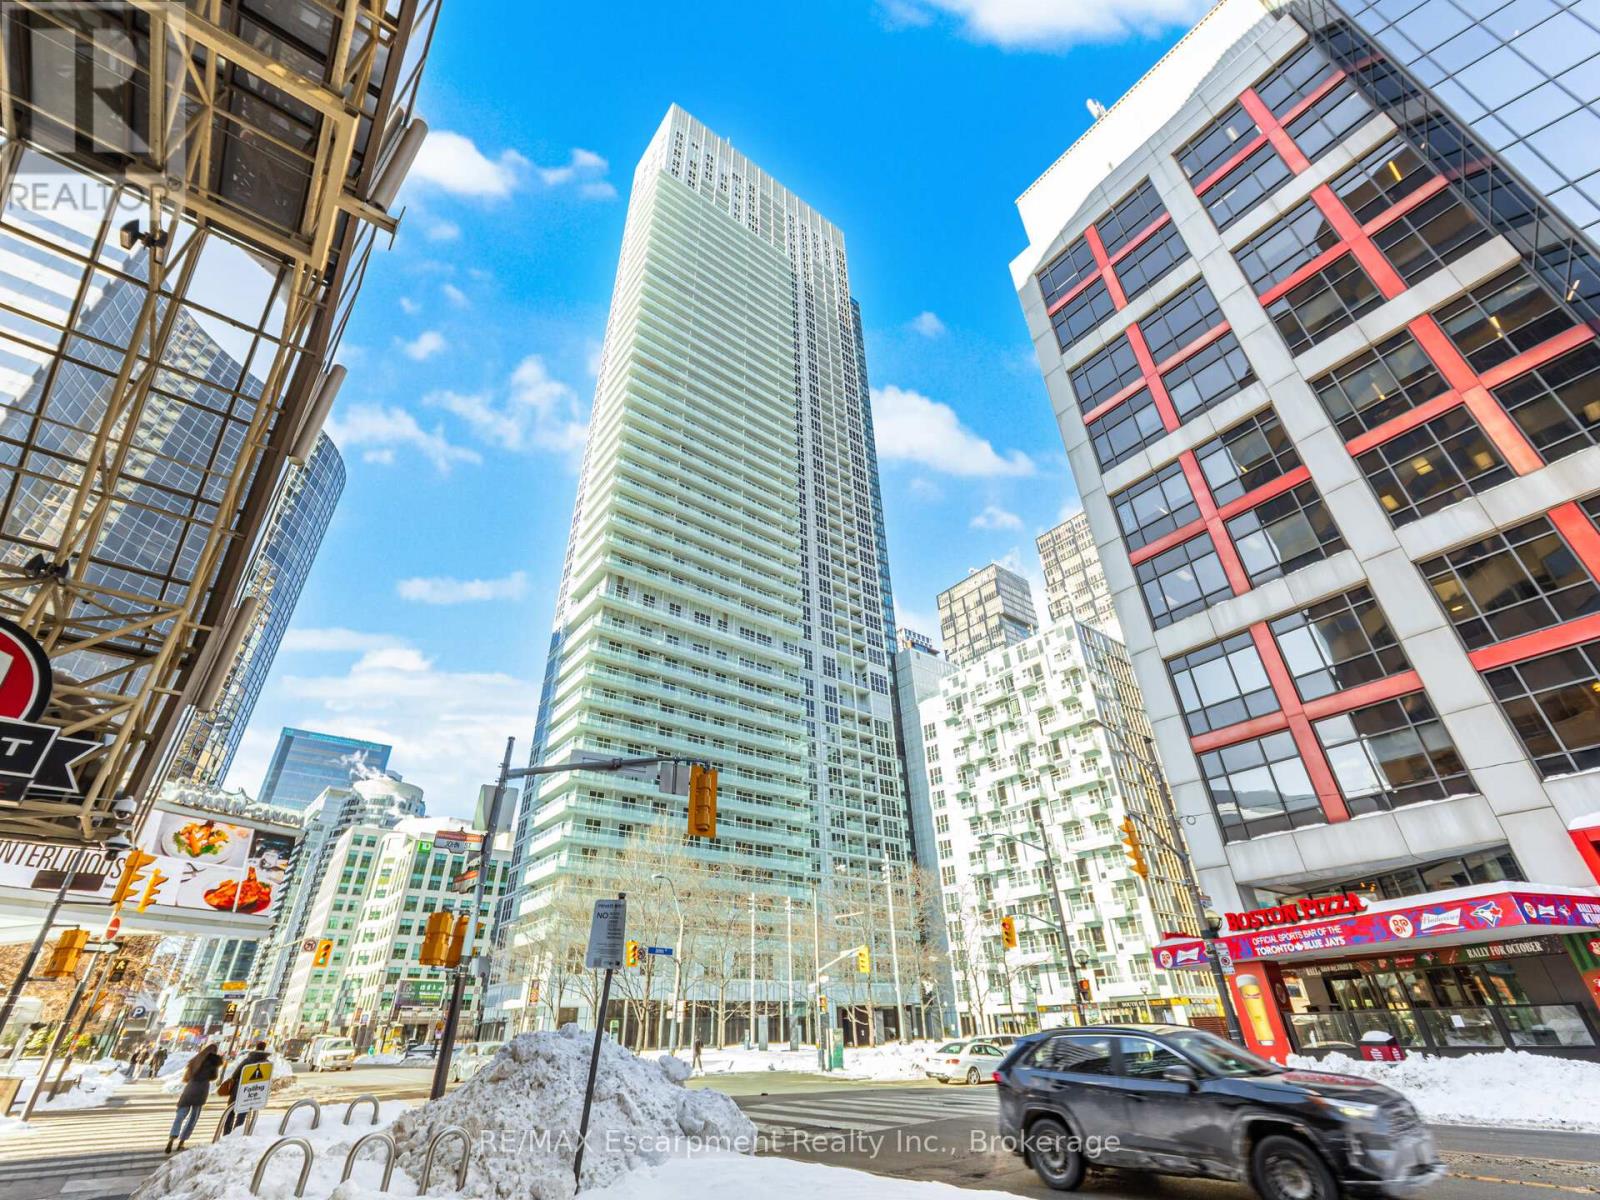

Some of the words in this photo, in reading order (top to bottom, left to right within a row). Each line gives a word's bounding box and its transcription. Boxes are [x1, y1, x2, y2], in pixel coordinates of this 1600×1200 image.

[1225, 904, 1300, 931] BOSTON
[1298, 892, 1368, 921] PIZZA
[1252, 934, 1278, 945] OFFICIAL
[1279, 931, 1303, 942] SPORTS
[1303, 929, 1318, 939] BAR
[1318, 927, 1327, 937] OF
[1328, 925, 1343, 936] THE
[1255, 943, 1295, 957] TORONTO
[1304, 939, 1323, 951] BLUE
[1324, 936, 1346, 948] JAYS
[1466, 947, 1490, 959] RALLY
[1489, 945, 1506, 956] FOR
[1505, 941, 1544, 954] OCTOBER
